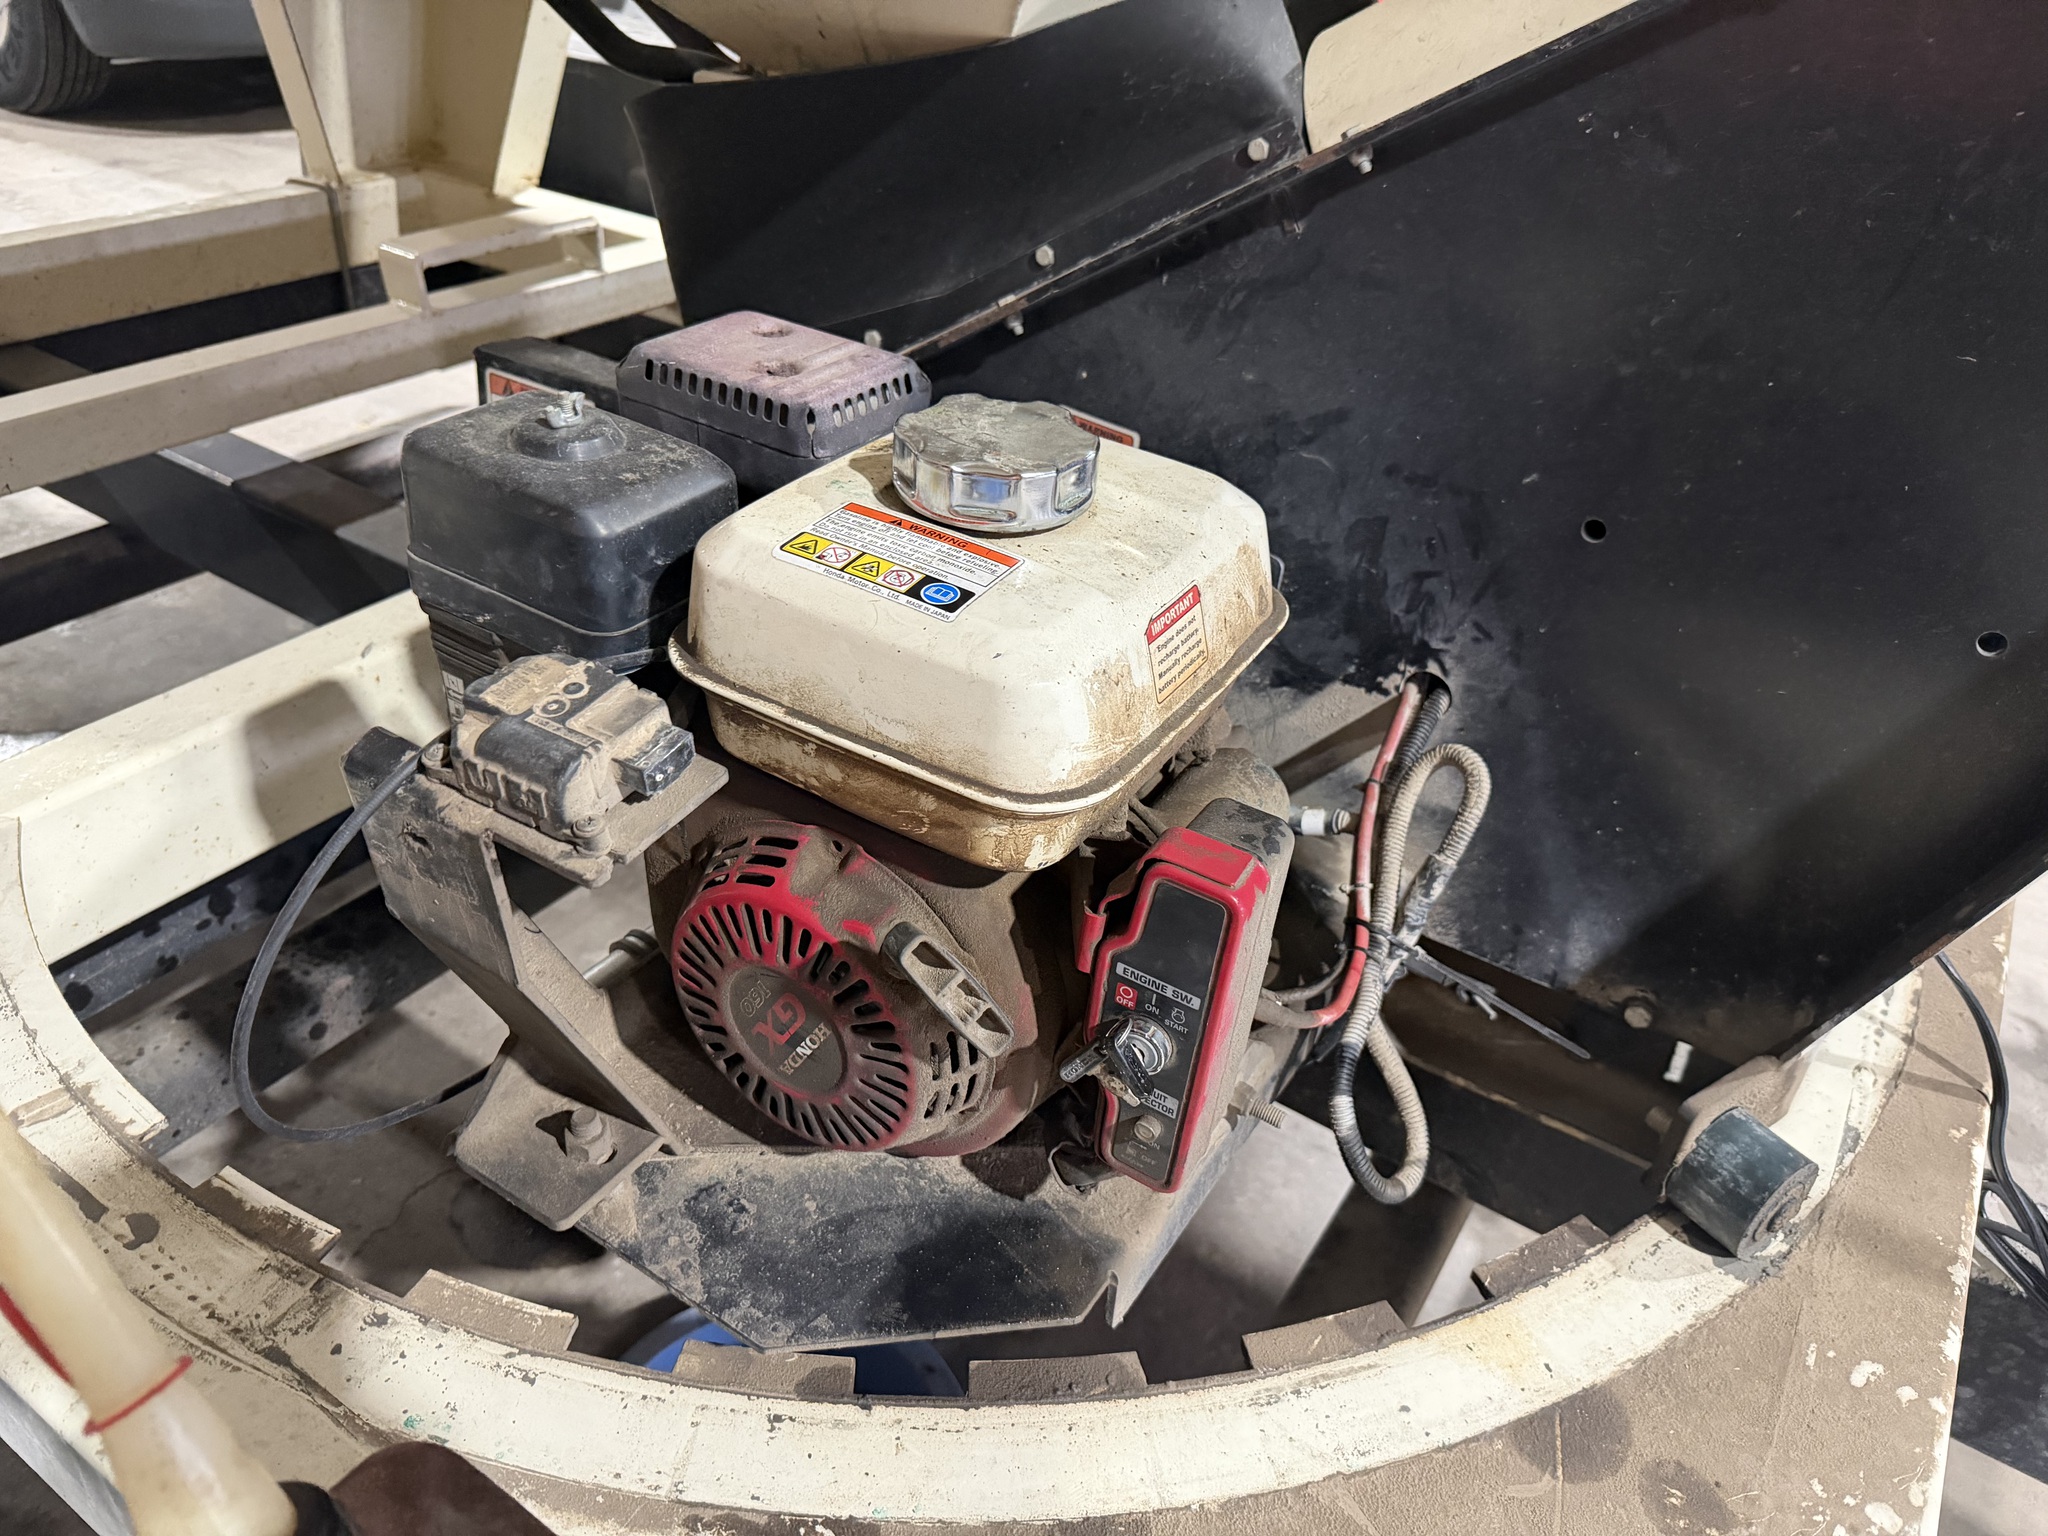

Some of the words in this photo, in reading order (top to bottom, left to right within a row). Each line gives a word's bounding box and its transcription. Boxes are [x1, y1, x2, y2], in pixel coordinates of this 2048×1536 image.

[839, 524, 864, 535] engine
[867, 532, 888, 542] emits
[890, 541, 907, 549] toxic
[910, 547, 936, 559] carbon
[937, 558, 978, 574] monoxide.
[851, 519, 876, 530] engine
[936, 548, 961, 559] before
[961, 557, 1000, 574] refueling.
[880, 524, 902, 533] highly
[963, 552, 1002, 568] explosive.
[880, 543, 917, 558] enclosed
[909, 524, 969, 548] WARNING
[811, 527, 828, 535] Read
[830, 534, 858, 546] Owner's
[859, 544, 887, 556] Manual
[888, 554, 911, 565] before
[911, 563, 950, 580] operation.
[823, 568, 846, 580] Honda
[886, 591, 900, 600] Ltd.
[905, 599, 922, 610] MADE
[931, 609, 951, 620] JAPAN
[1151, 592, 1194, 636] IMPORTANT
[1157, 635, 1175, 653] Engine
[1175, 623, 1188, 635] does
[1158, 644, 1180, 666] recharge
[1158, 656, 1181, 680] Manually
[1181, 638, 1202, 660] recharge
[1158, 675, 1177, 694] battery
[740, 980, 771, 1017] 160
[1115, 996, 1134, 1008] OFF
[1122, 967, 1169, 993] ENGINE
[1171, 989, 1195, 1006] SW.
[751, 992, 806, 1056] GX
[1144, 1003, 1160, 1015] ON
[1164, 1019, 1188, 1035] START
[780, 1022, 832, 1075] HONDA
